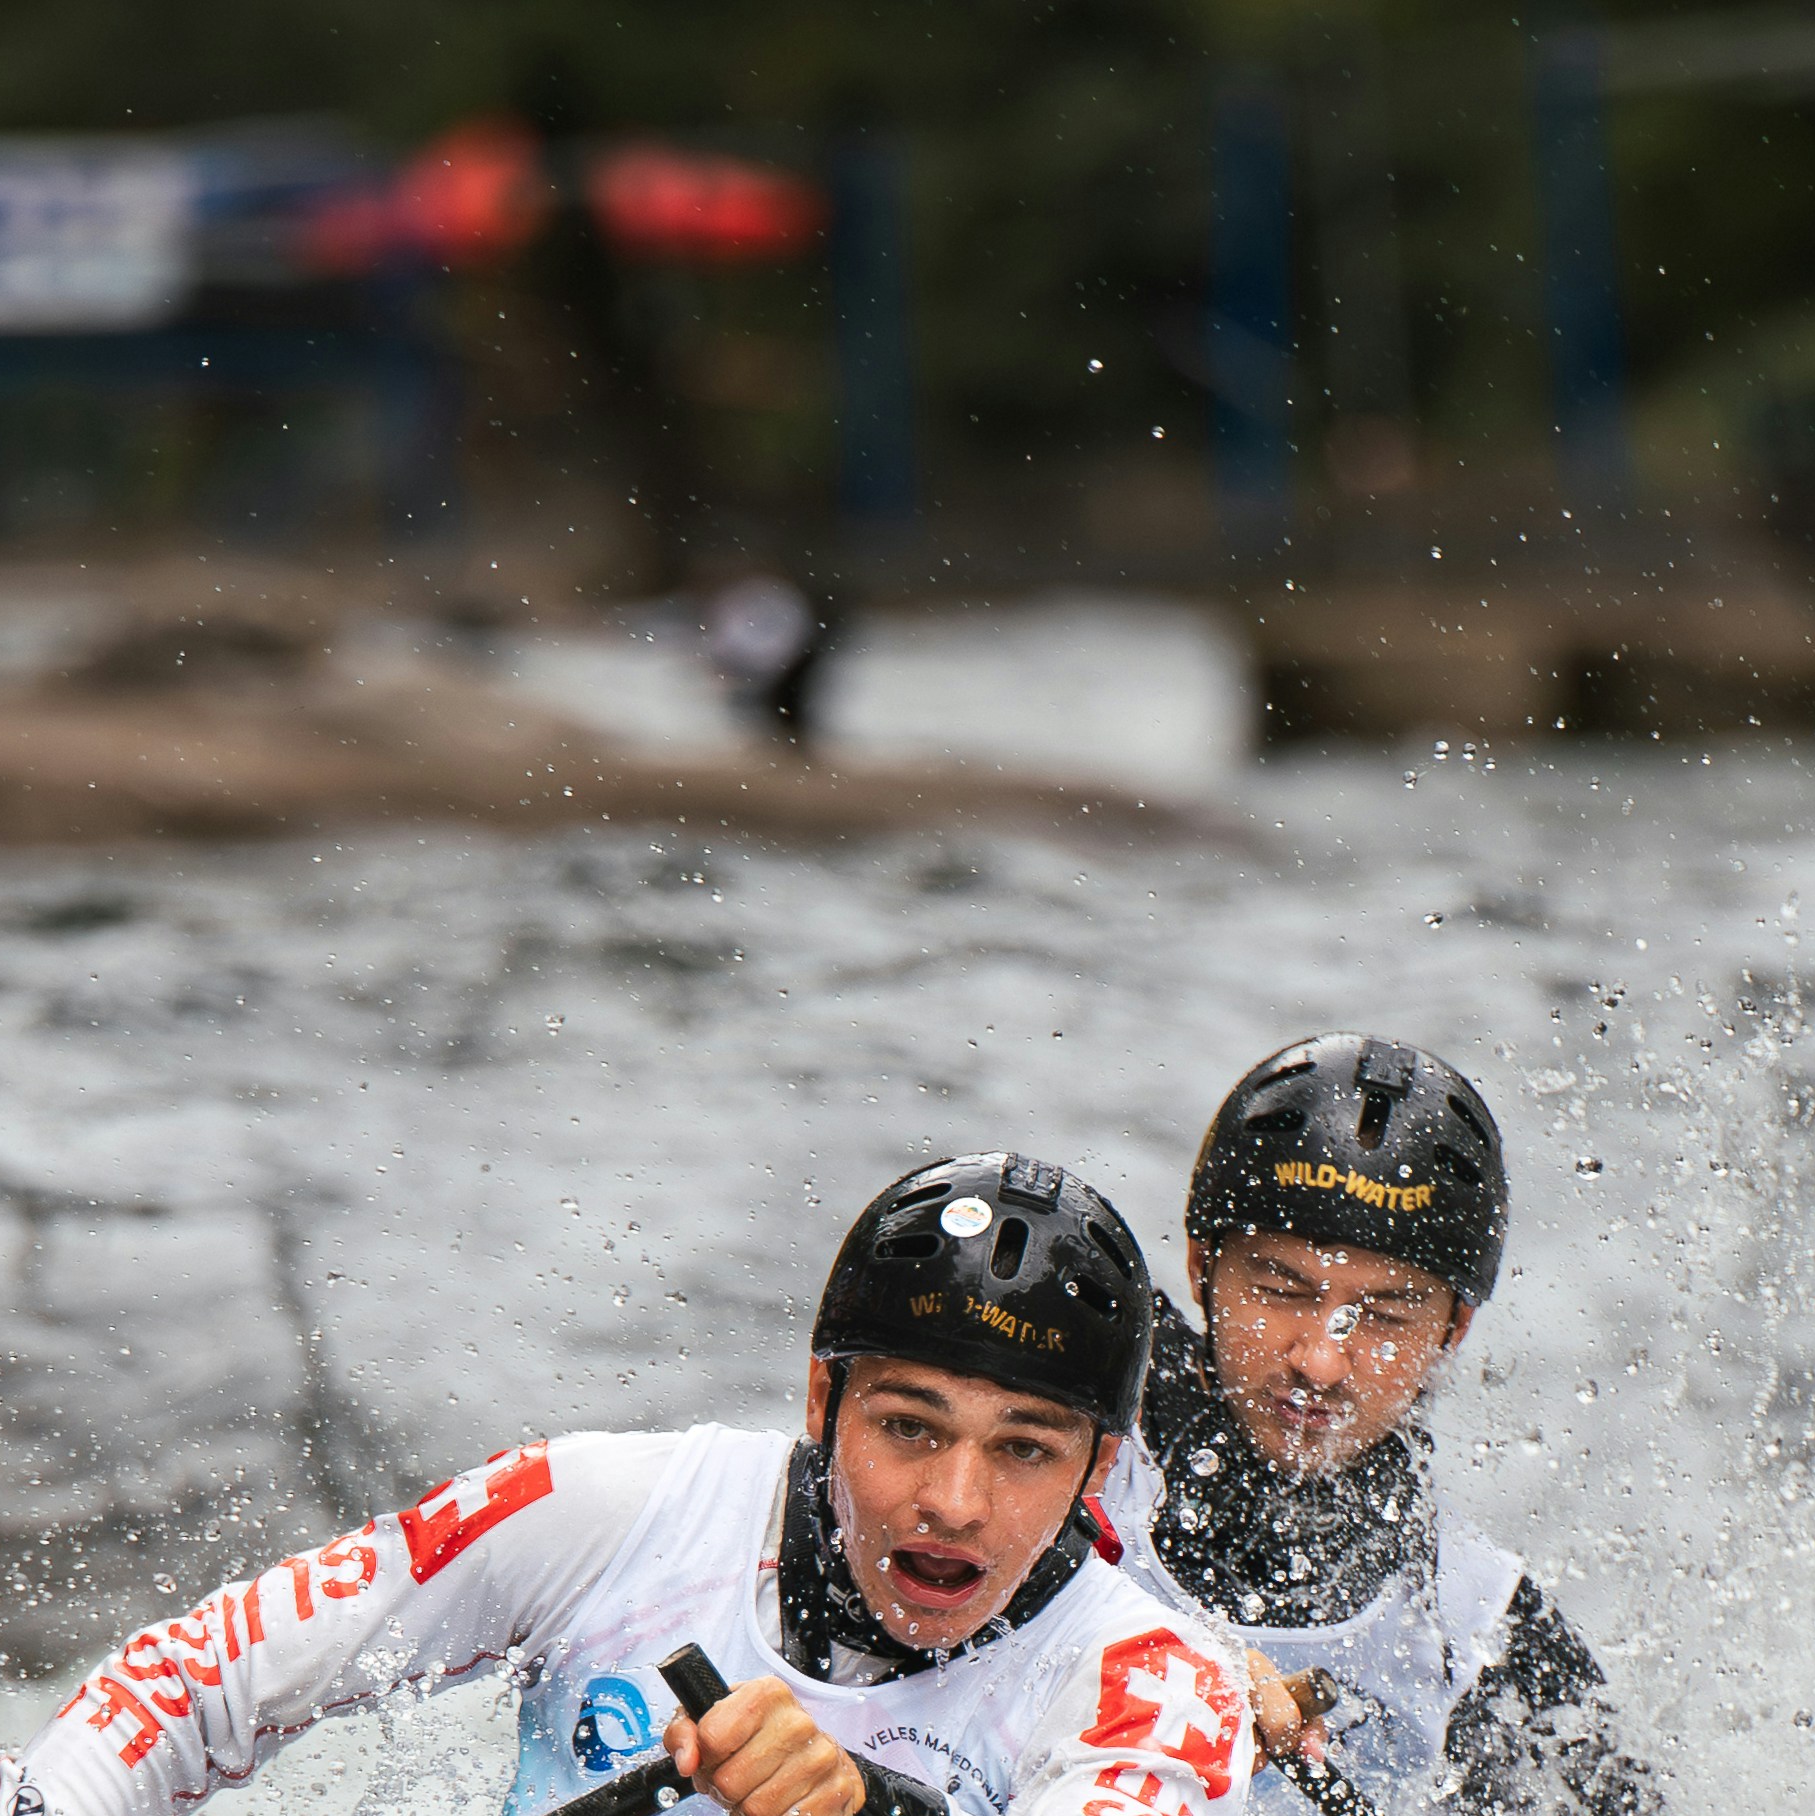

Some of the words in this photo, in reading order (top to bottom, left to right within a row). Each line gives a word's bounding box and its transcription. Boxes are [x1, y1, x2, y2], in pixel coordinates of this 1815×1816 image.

[1274, 1160, 1431, 1212] WILD-WATER
[863, 1726, 920, 1751] VELES,
[924, 1733, 1005, 1816] MAEDONIA
